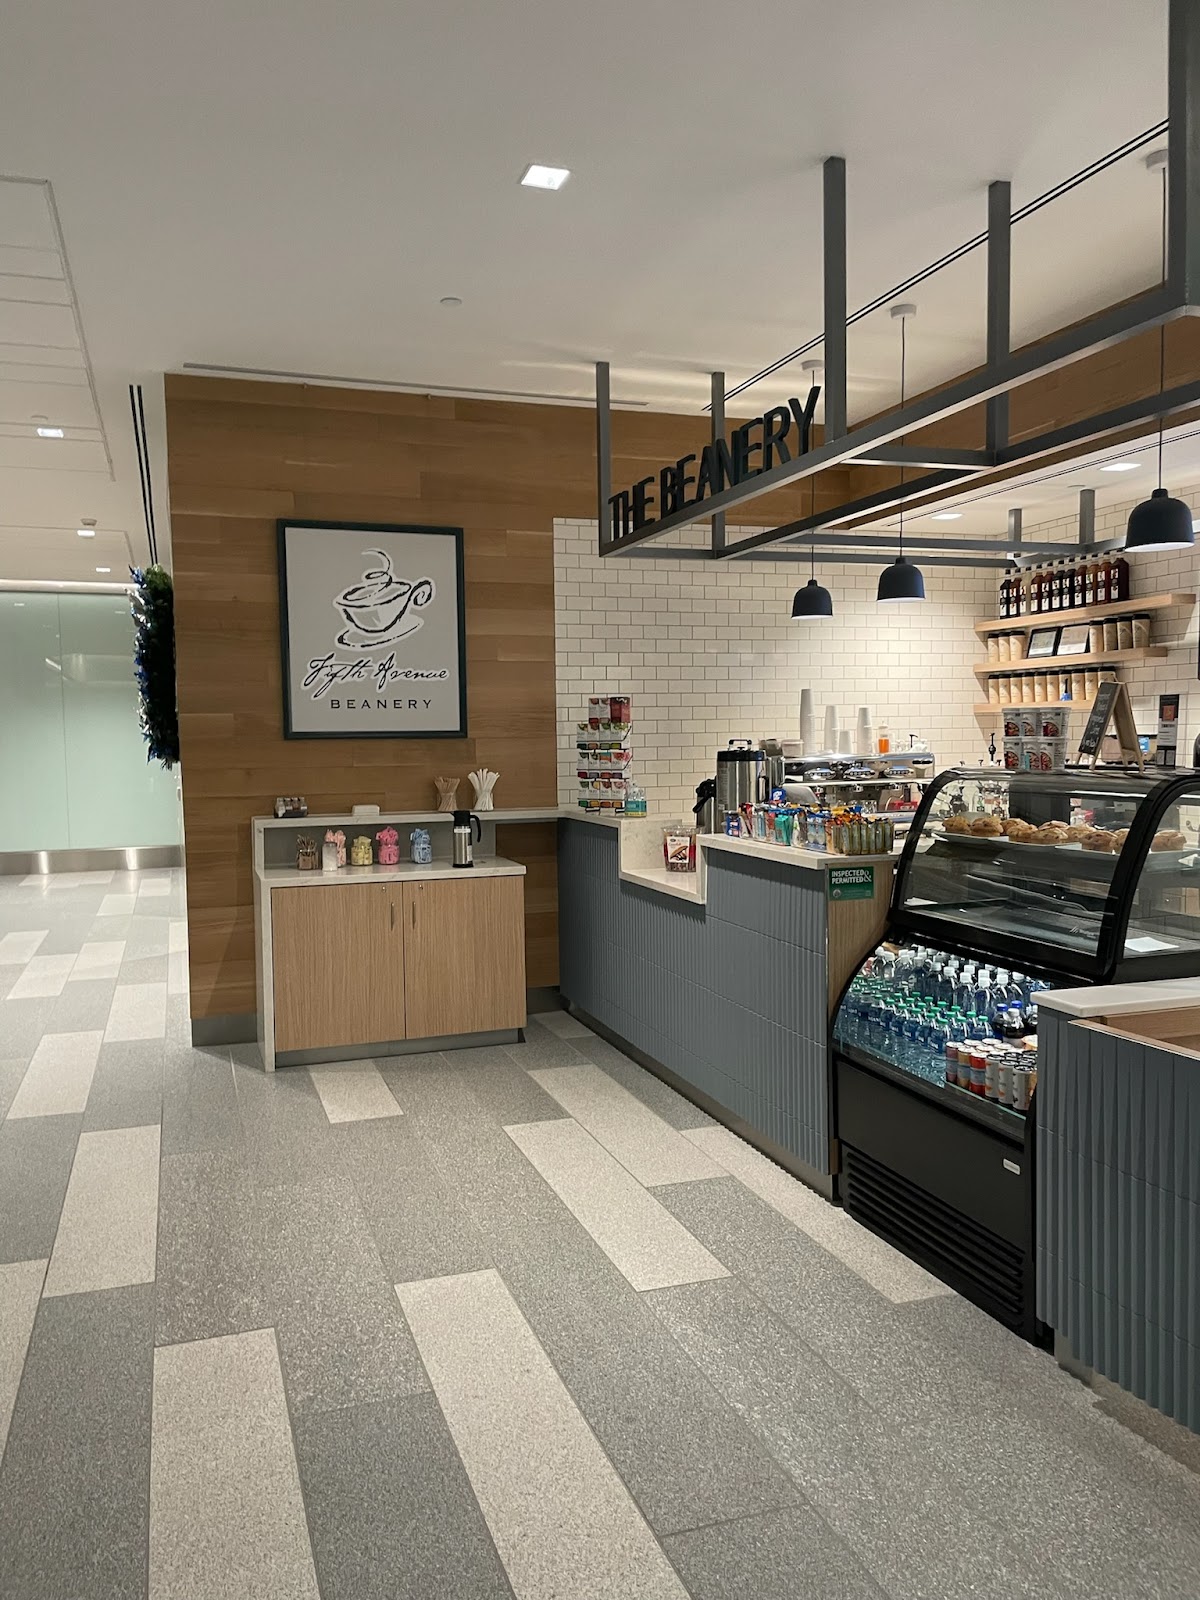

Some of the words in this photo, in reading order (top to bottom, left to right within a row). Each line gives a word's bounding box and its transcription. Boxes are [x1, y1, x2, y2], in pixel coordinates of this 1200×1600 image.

[608, 476, 655, 542] THE
[660, 386, 821, 519] BEANERY
[303, 652, 374, 698] Fifth
[374, 651, 448, 690] Avenue
[330, 699, 432, 709] BEANERY
[832, 869, 864, 877] INSPECTED
[832, 876, 864, 884] PERMITTED
